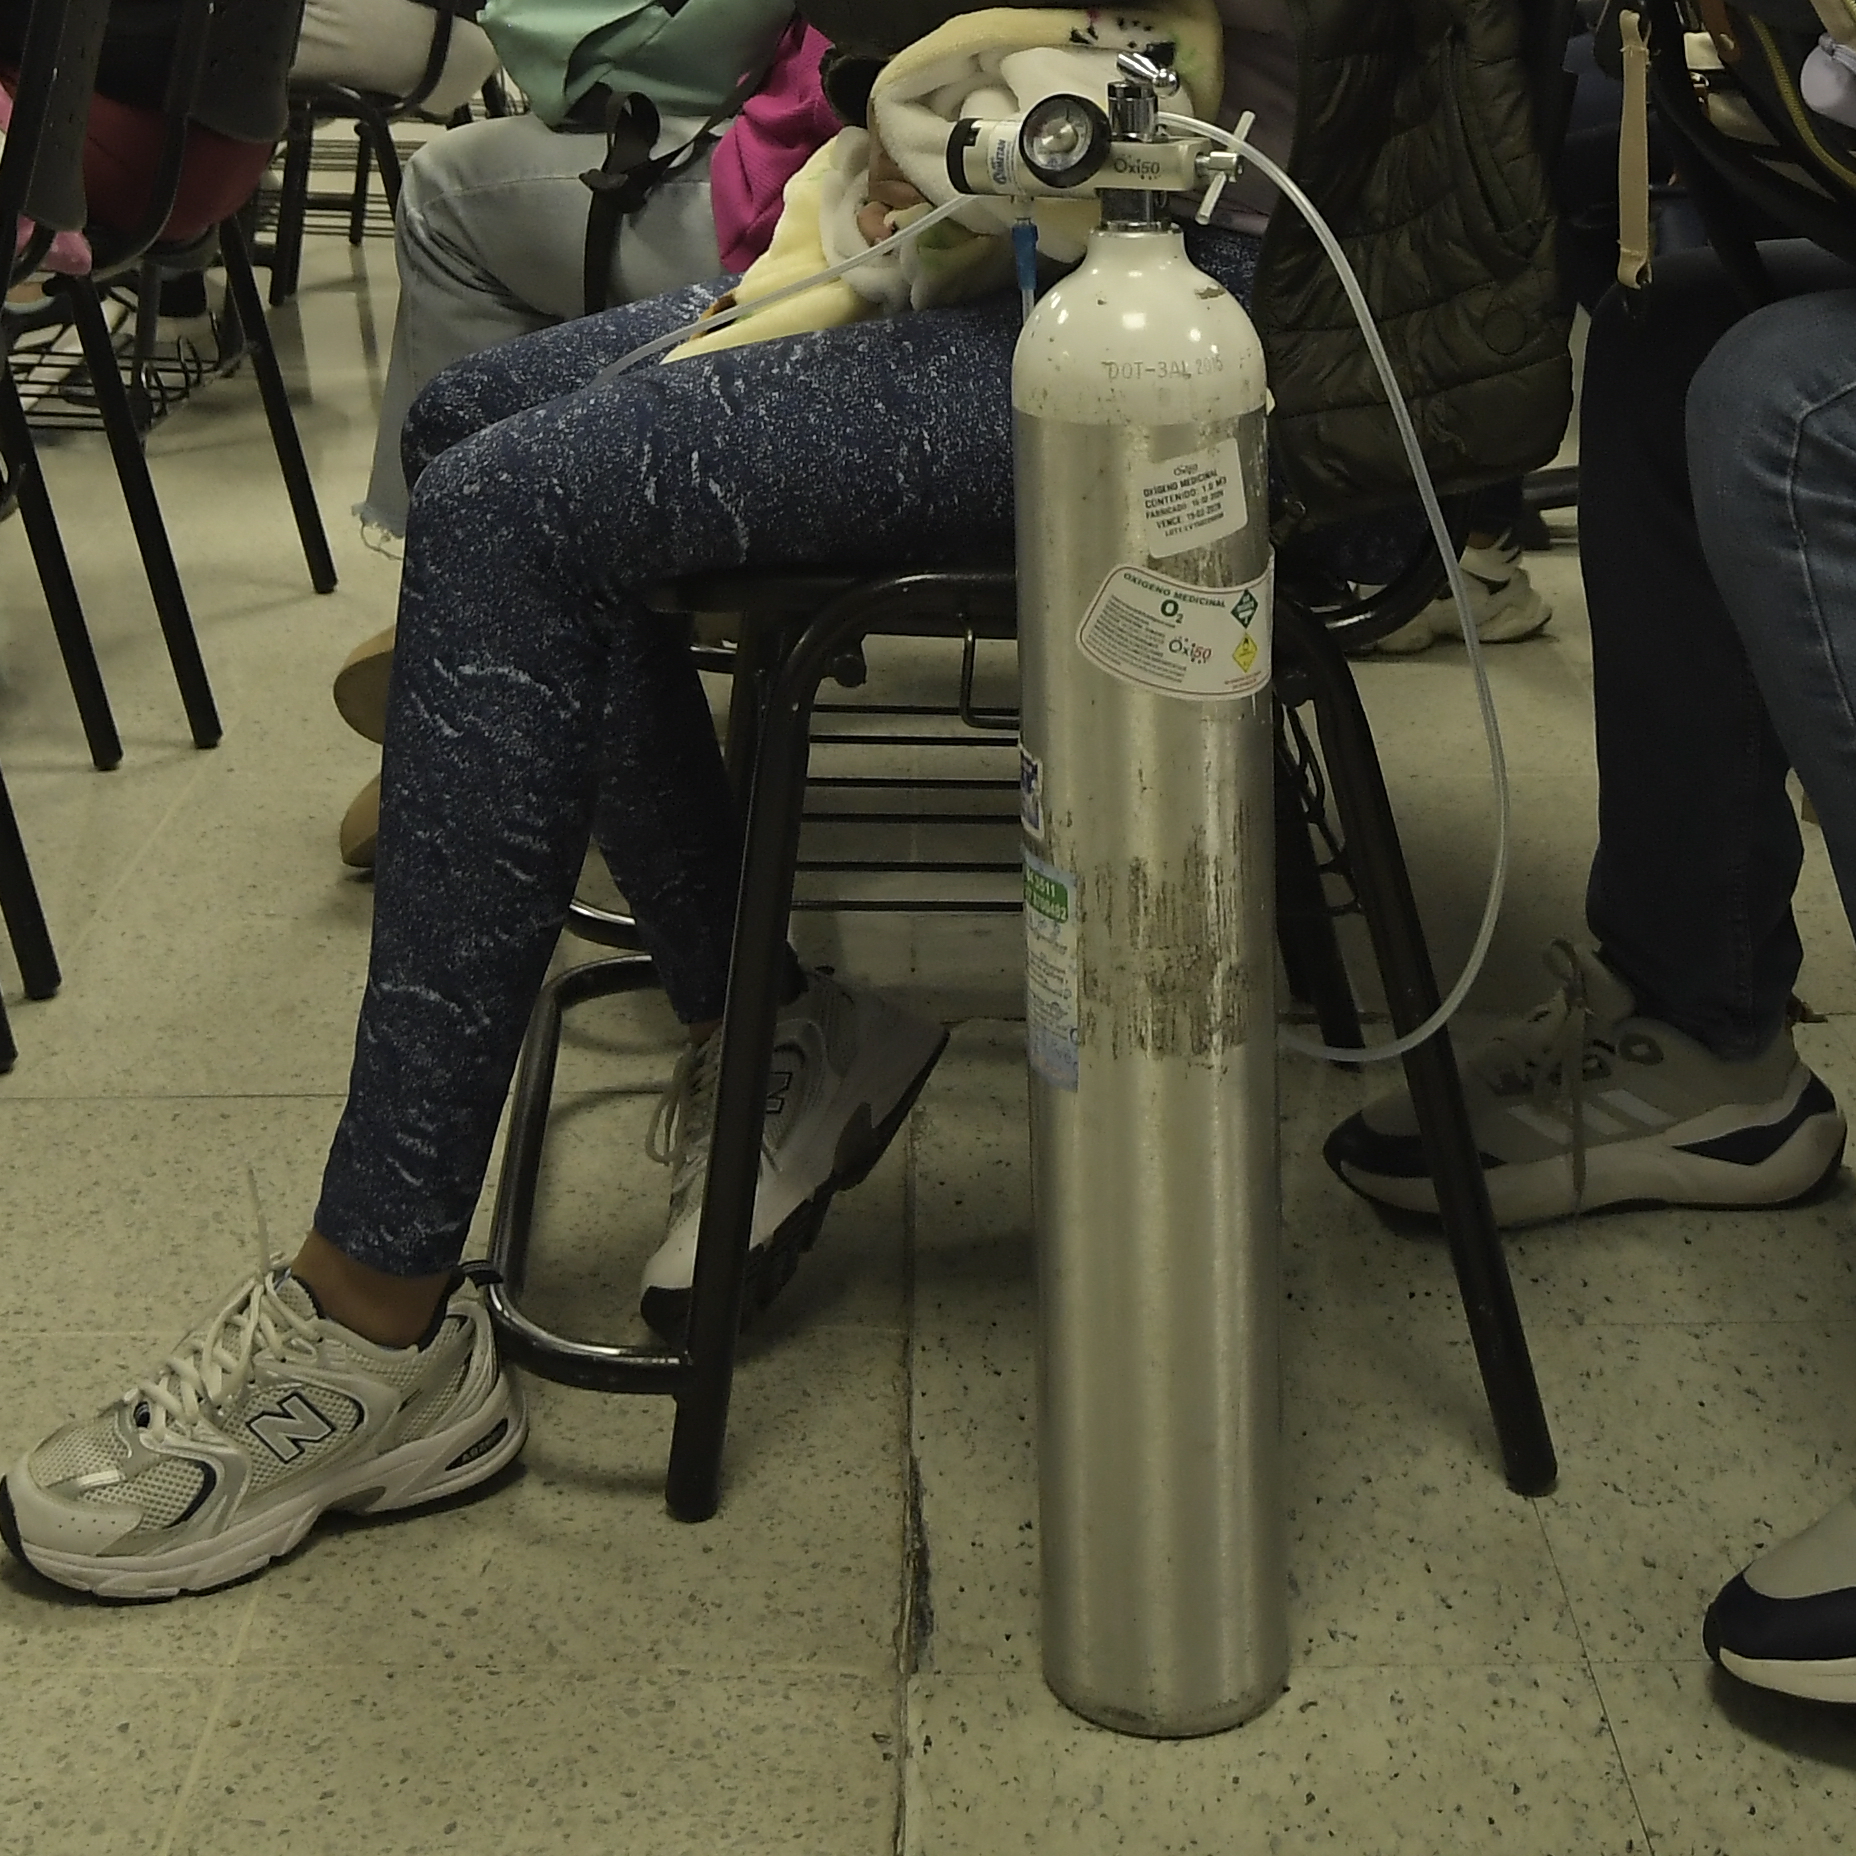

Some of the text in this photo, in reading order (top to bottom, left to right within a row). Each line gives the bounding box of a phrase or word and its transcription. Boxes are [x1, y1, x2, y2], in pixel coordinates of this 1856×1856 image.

[1179, 468, 1218, 488] MEDICINAL
[1173, 591, 1226, 608] MEDICINAL
[245, 1391, 336, 1464] N
